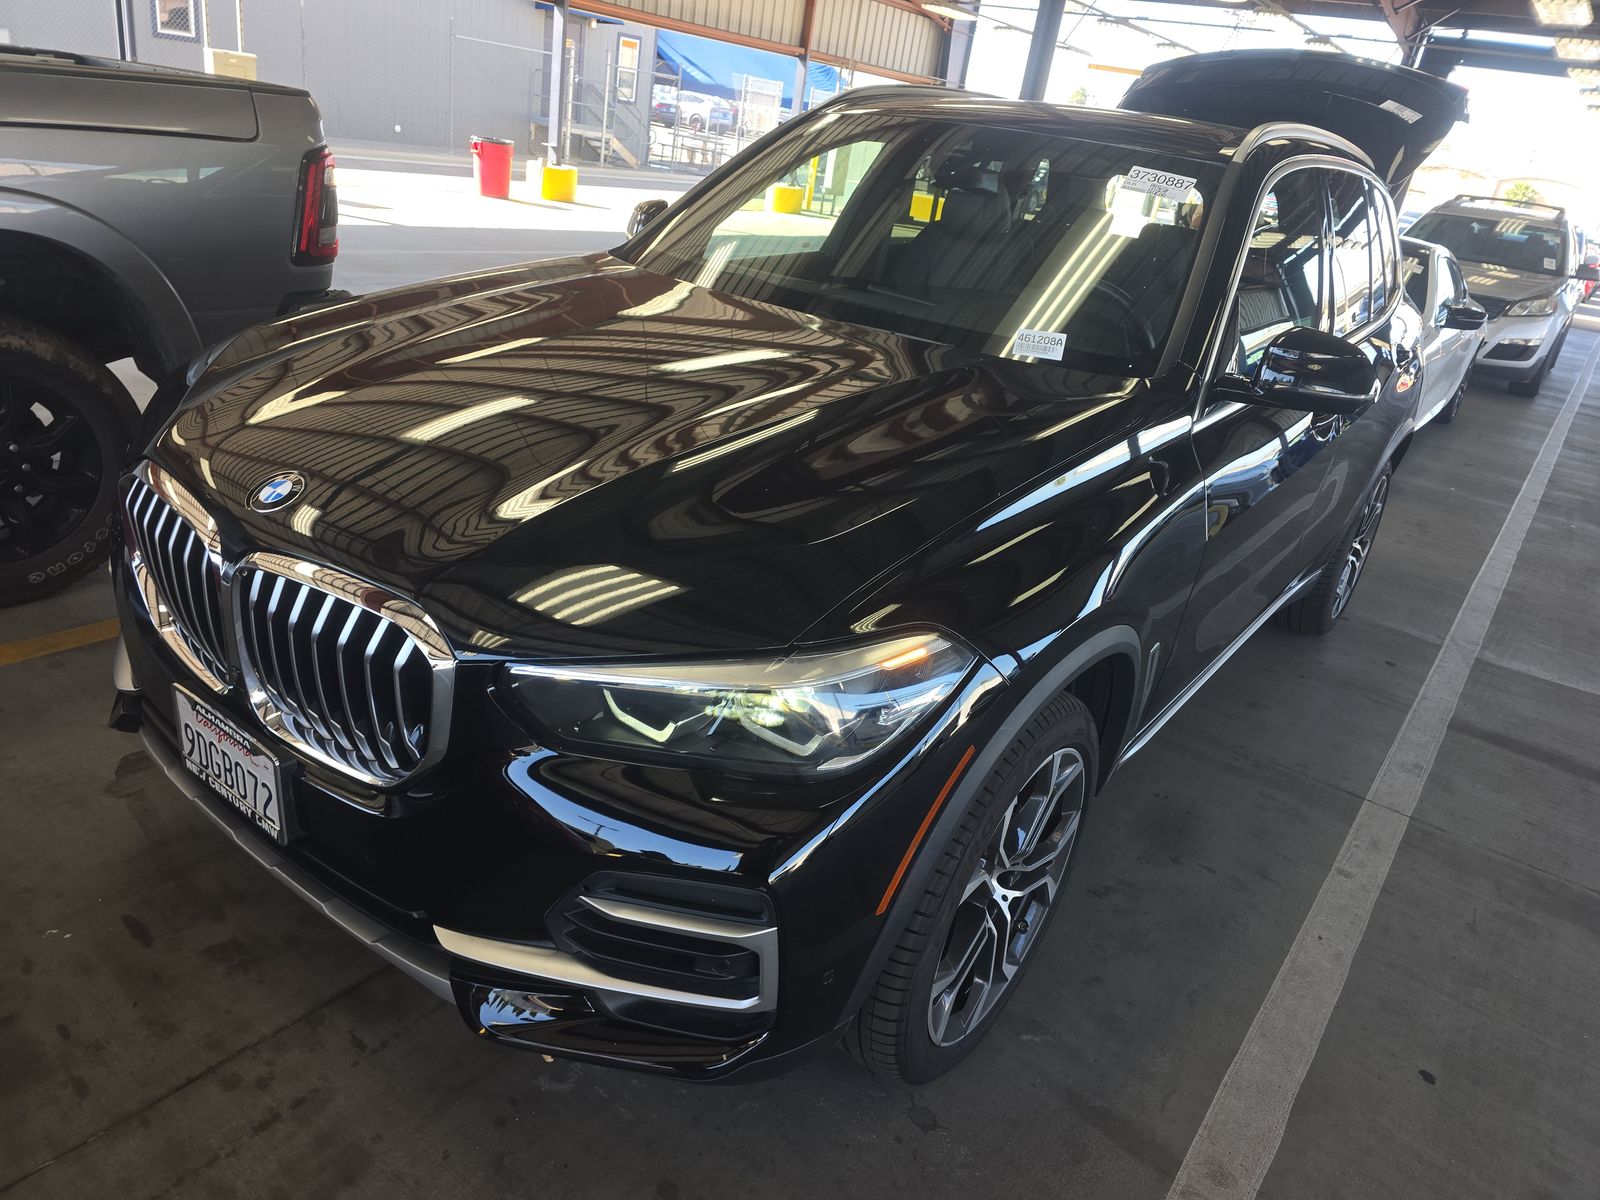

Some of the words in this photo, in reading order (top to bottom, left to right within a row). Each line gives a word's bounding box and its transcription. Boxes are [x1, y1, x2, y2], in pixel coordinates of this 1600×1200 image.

[1130, 169, 1194, 190] 3730887
[1018, 333, 1063, 347] 461208A
[195, 704, 251, 749] ALHAMBRA
[184, 722, 276, 826] 9DGB072
[208, 777, 253, 818] CENTURY
